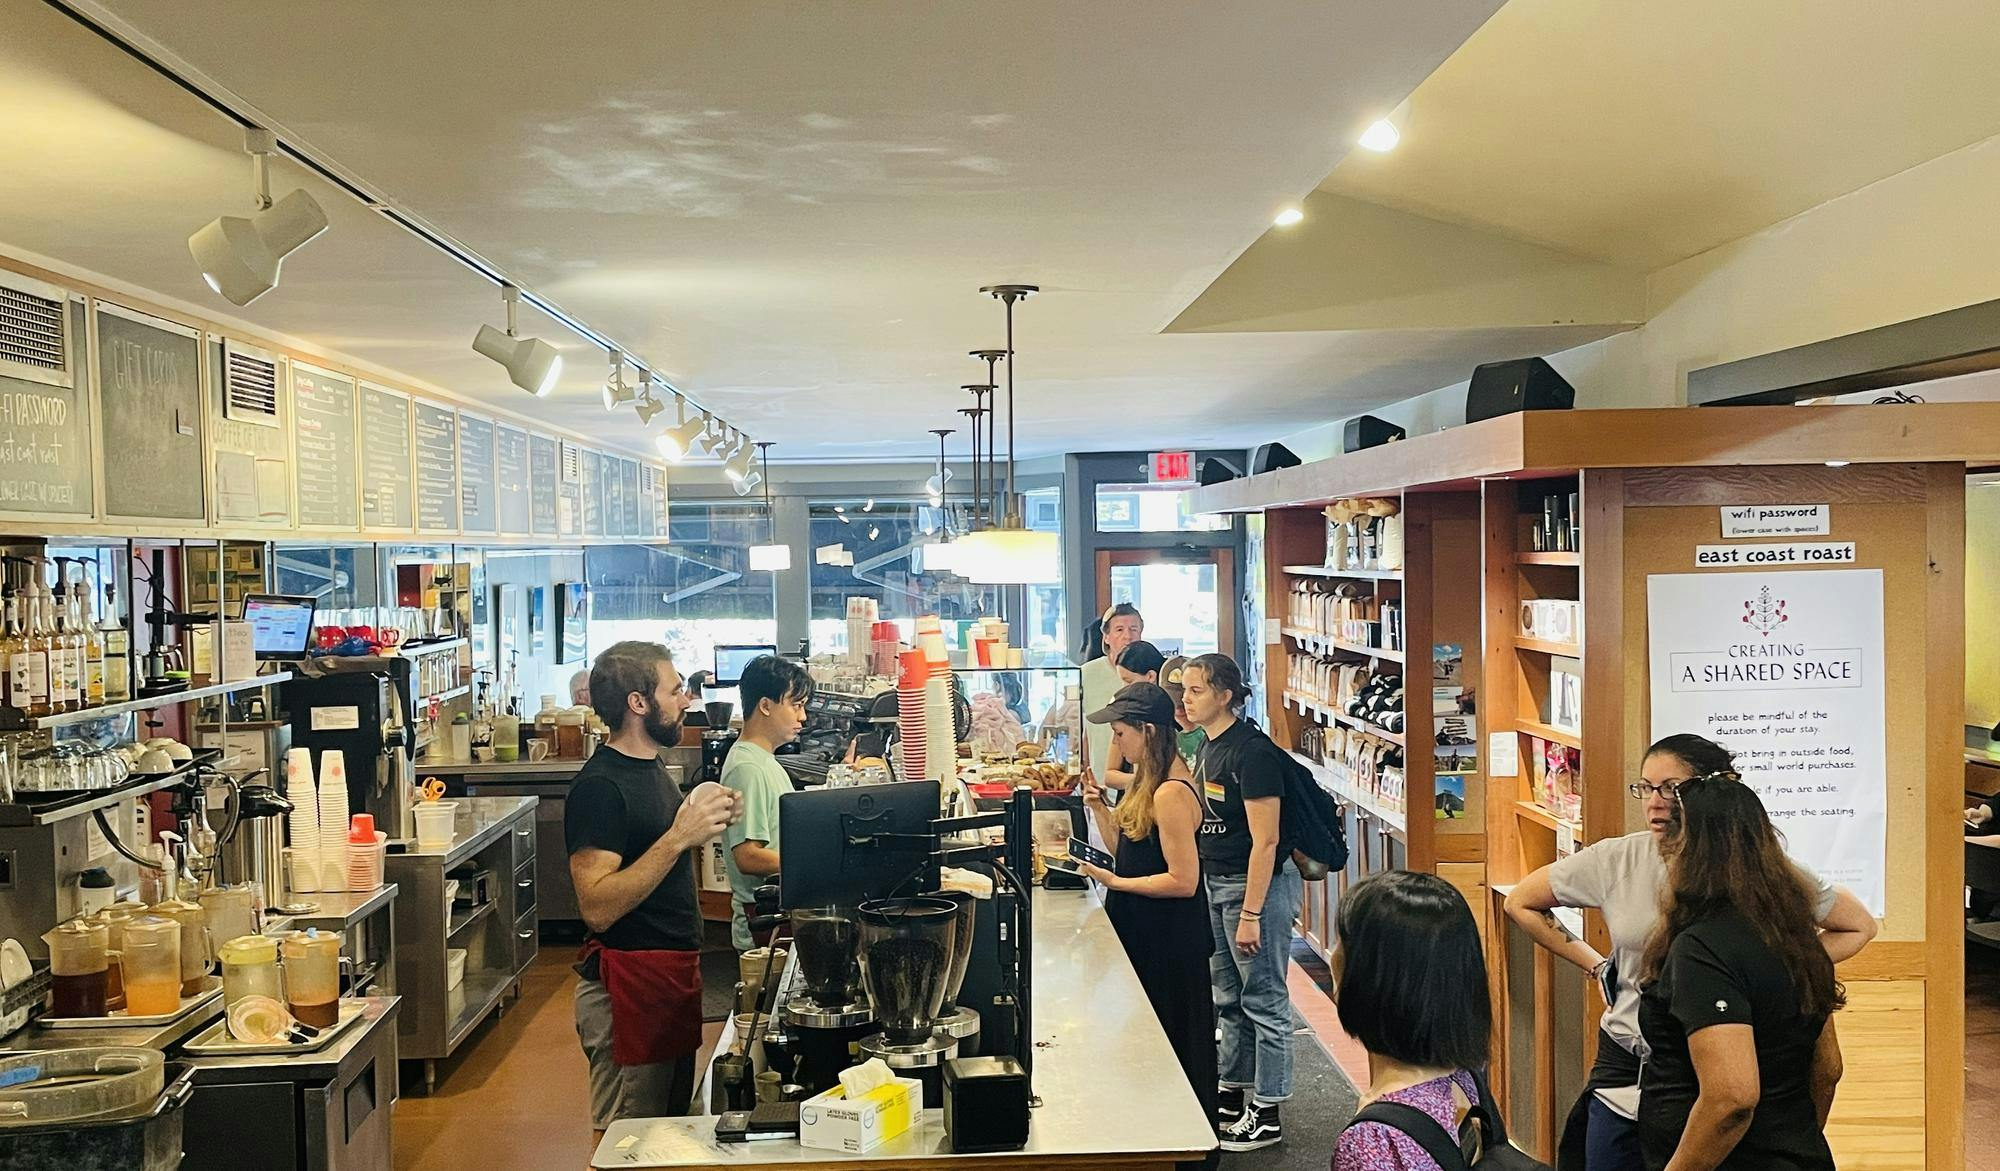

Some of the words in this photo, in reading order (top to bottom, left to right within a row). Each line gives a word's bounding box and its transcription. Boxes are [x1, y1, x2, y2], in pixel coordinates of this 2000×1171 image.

[16, 392, 66, 426] PASSWORD
[1156, 453, 1189, 480] EXIT
[1731, 507, 1755, 519] wifi
[1759, 506, 1818, 521] password
[1698, 548, 1739, 564] east
[1745, 547, 1796, 563] coast
[1803, 545, 1852, 561] roast
[1728, 643, 1805, 658] CREATING
[1682, 665, 1696, 683] A
[1703, 662, 1785, 683] SHARED
[1793, 661, 1852, 681] SPACE
[1708, 713, 1740, 724] please
[1742, 712, 1755, 721] be
[1758, 711, 1795, 721] mindful
[1799, 710, 1808, 719] of
[1812, 710, 1828, 719] the
[1716, 726, 1758, 736] duration
[1761, 725, 1771, 735] of
[1774, 727, 1797, 737] your
[1799, 725, 1821, 736] stay.
[1751, 750, 1775, 760] bring
[1790, 748, 1826, 757] outside
[1749, 762, 1773, 771] small
[1776, 761, 1804, 771] world
[1765, 784, 1773, 794] if
[1775, 786, 1793, 797] you
[1801, 808, 1818, 817] the
[1201, 824, 1227, 835] OYD
